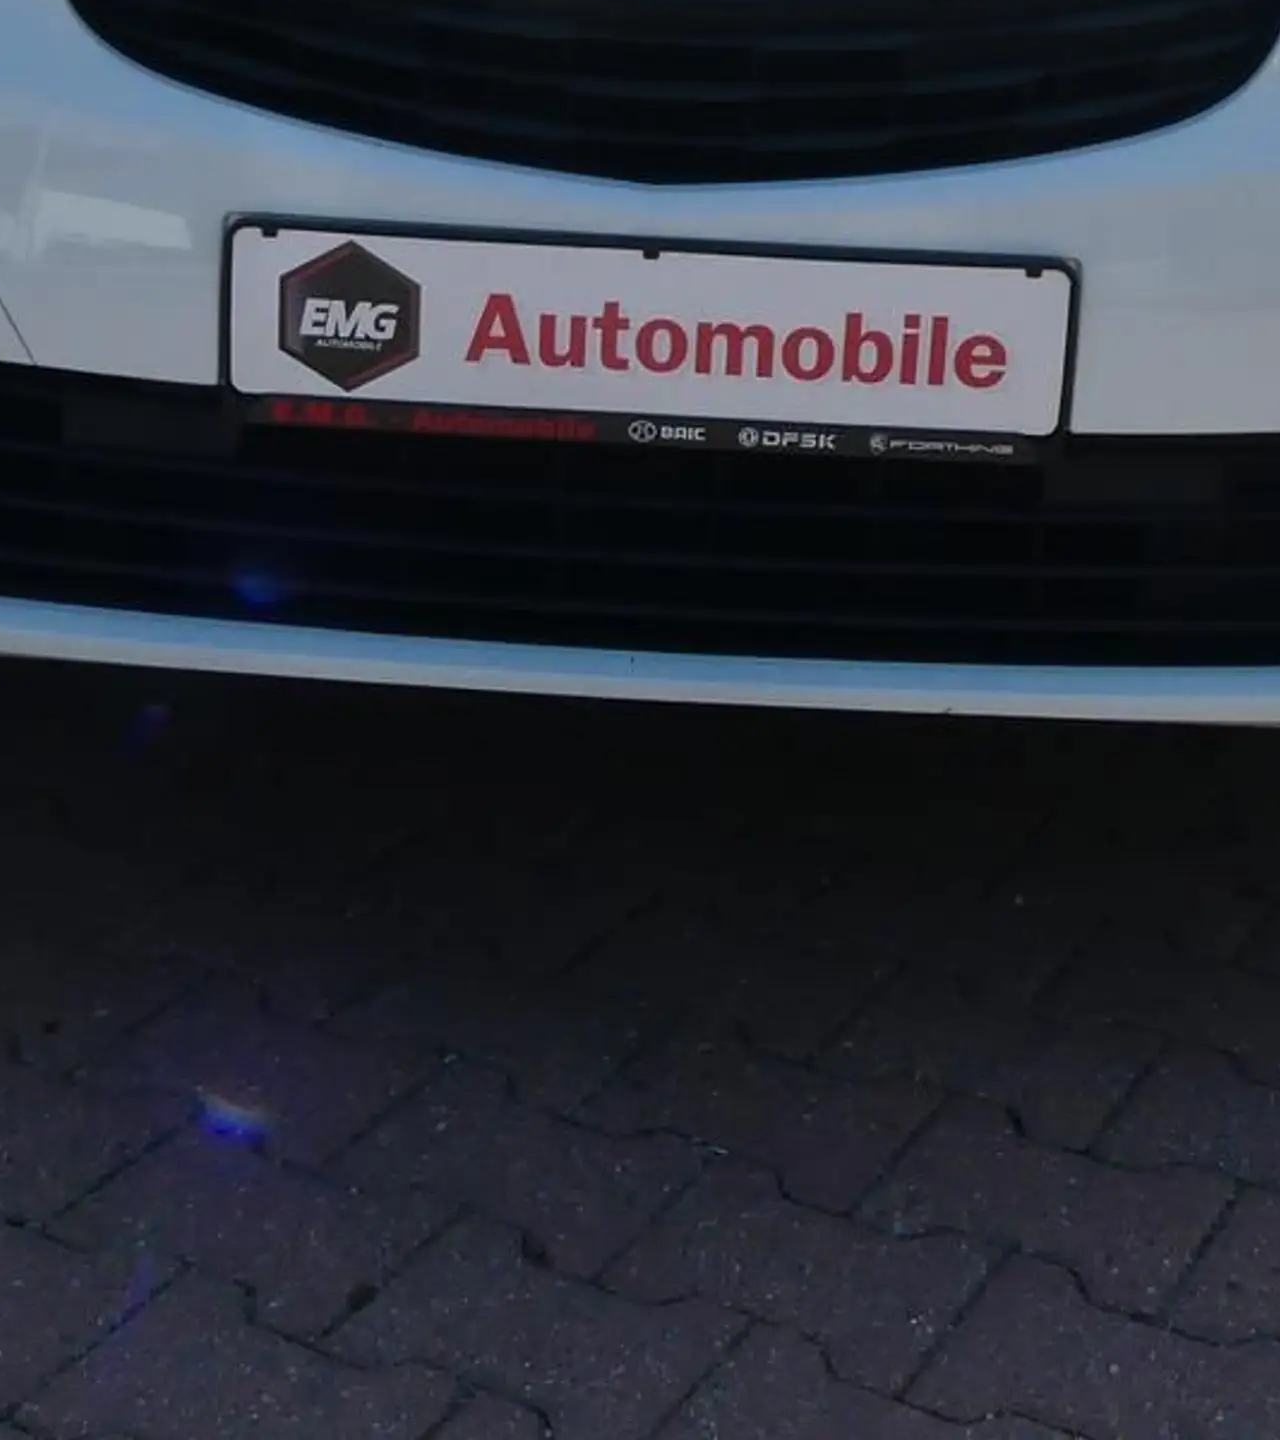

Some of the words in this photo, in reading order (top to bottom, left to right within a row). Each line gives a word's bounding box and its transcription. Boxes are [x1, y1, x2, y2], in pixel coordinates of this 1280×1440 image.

[299, 297, 400, 340] EMG
[465, 293, 1008, 389] Automobile
[761, 430, 837, 451] DFSK
